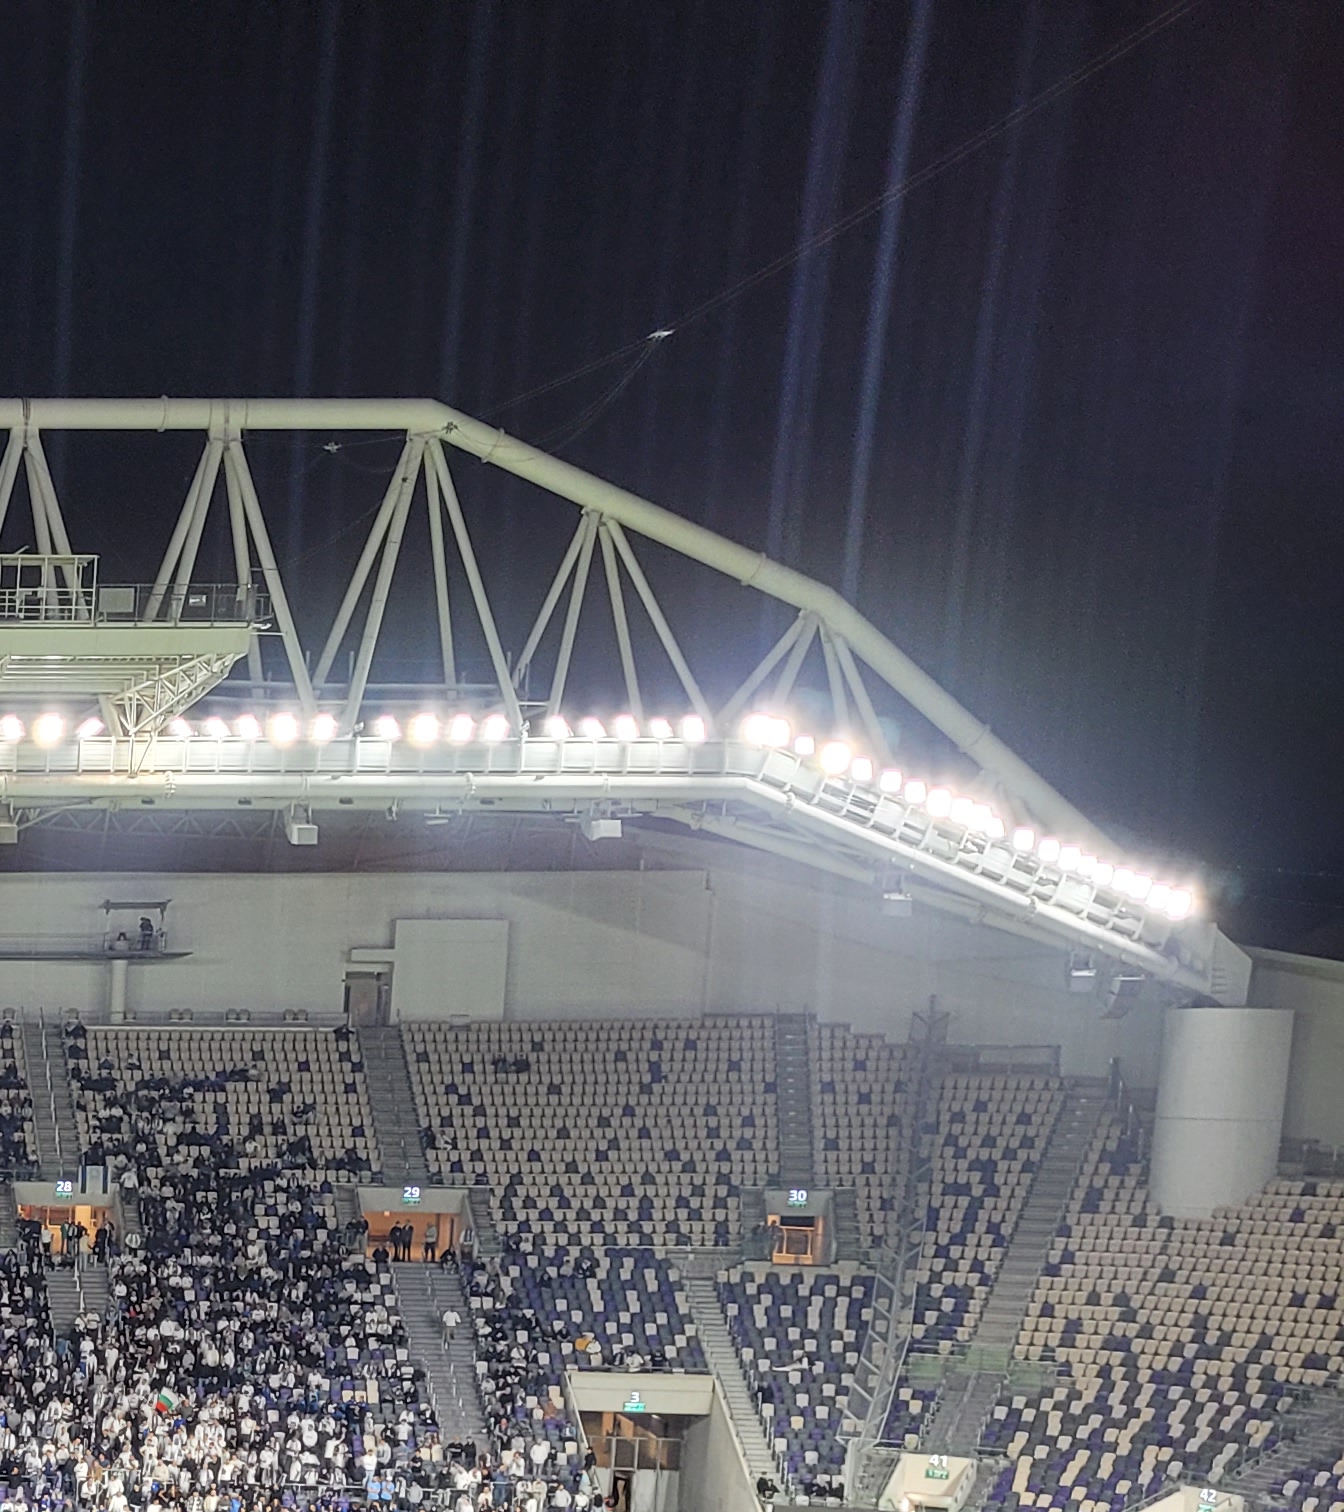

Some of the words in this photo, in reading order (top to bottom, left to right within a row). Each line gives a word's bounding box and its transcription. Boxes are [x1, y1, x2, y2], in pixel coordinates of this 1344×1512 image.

[56, 1181, 73, 1192] 28
[403, 1187, 420, 1198] 29
[789, 1190, 807, 1201] 30
[630, 1392, 640, 1402] 3
[928, 1454, 948, 1468] 41
[1199, 1489, 1217, 1503] 42
